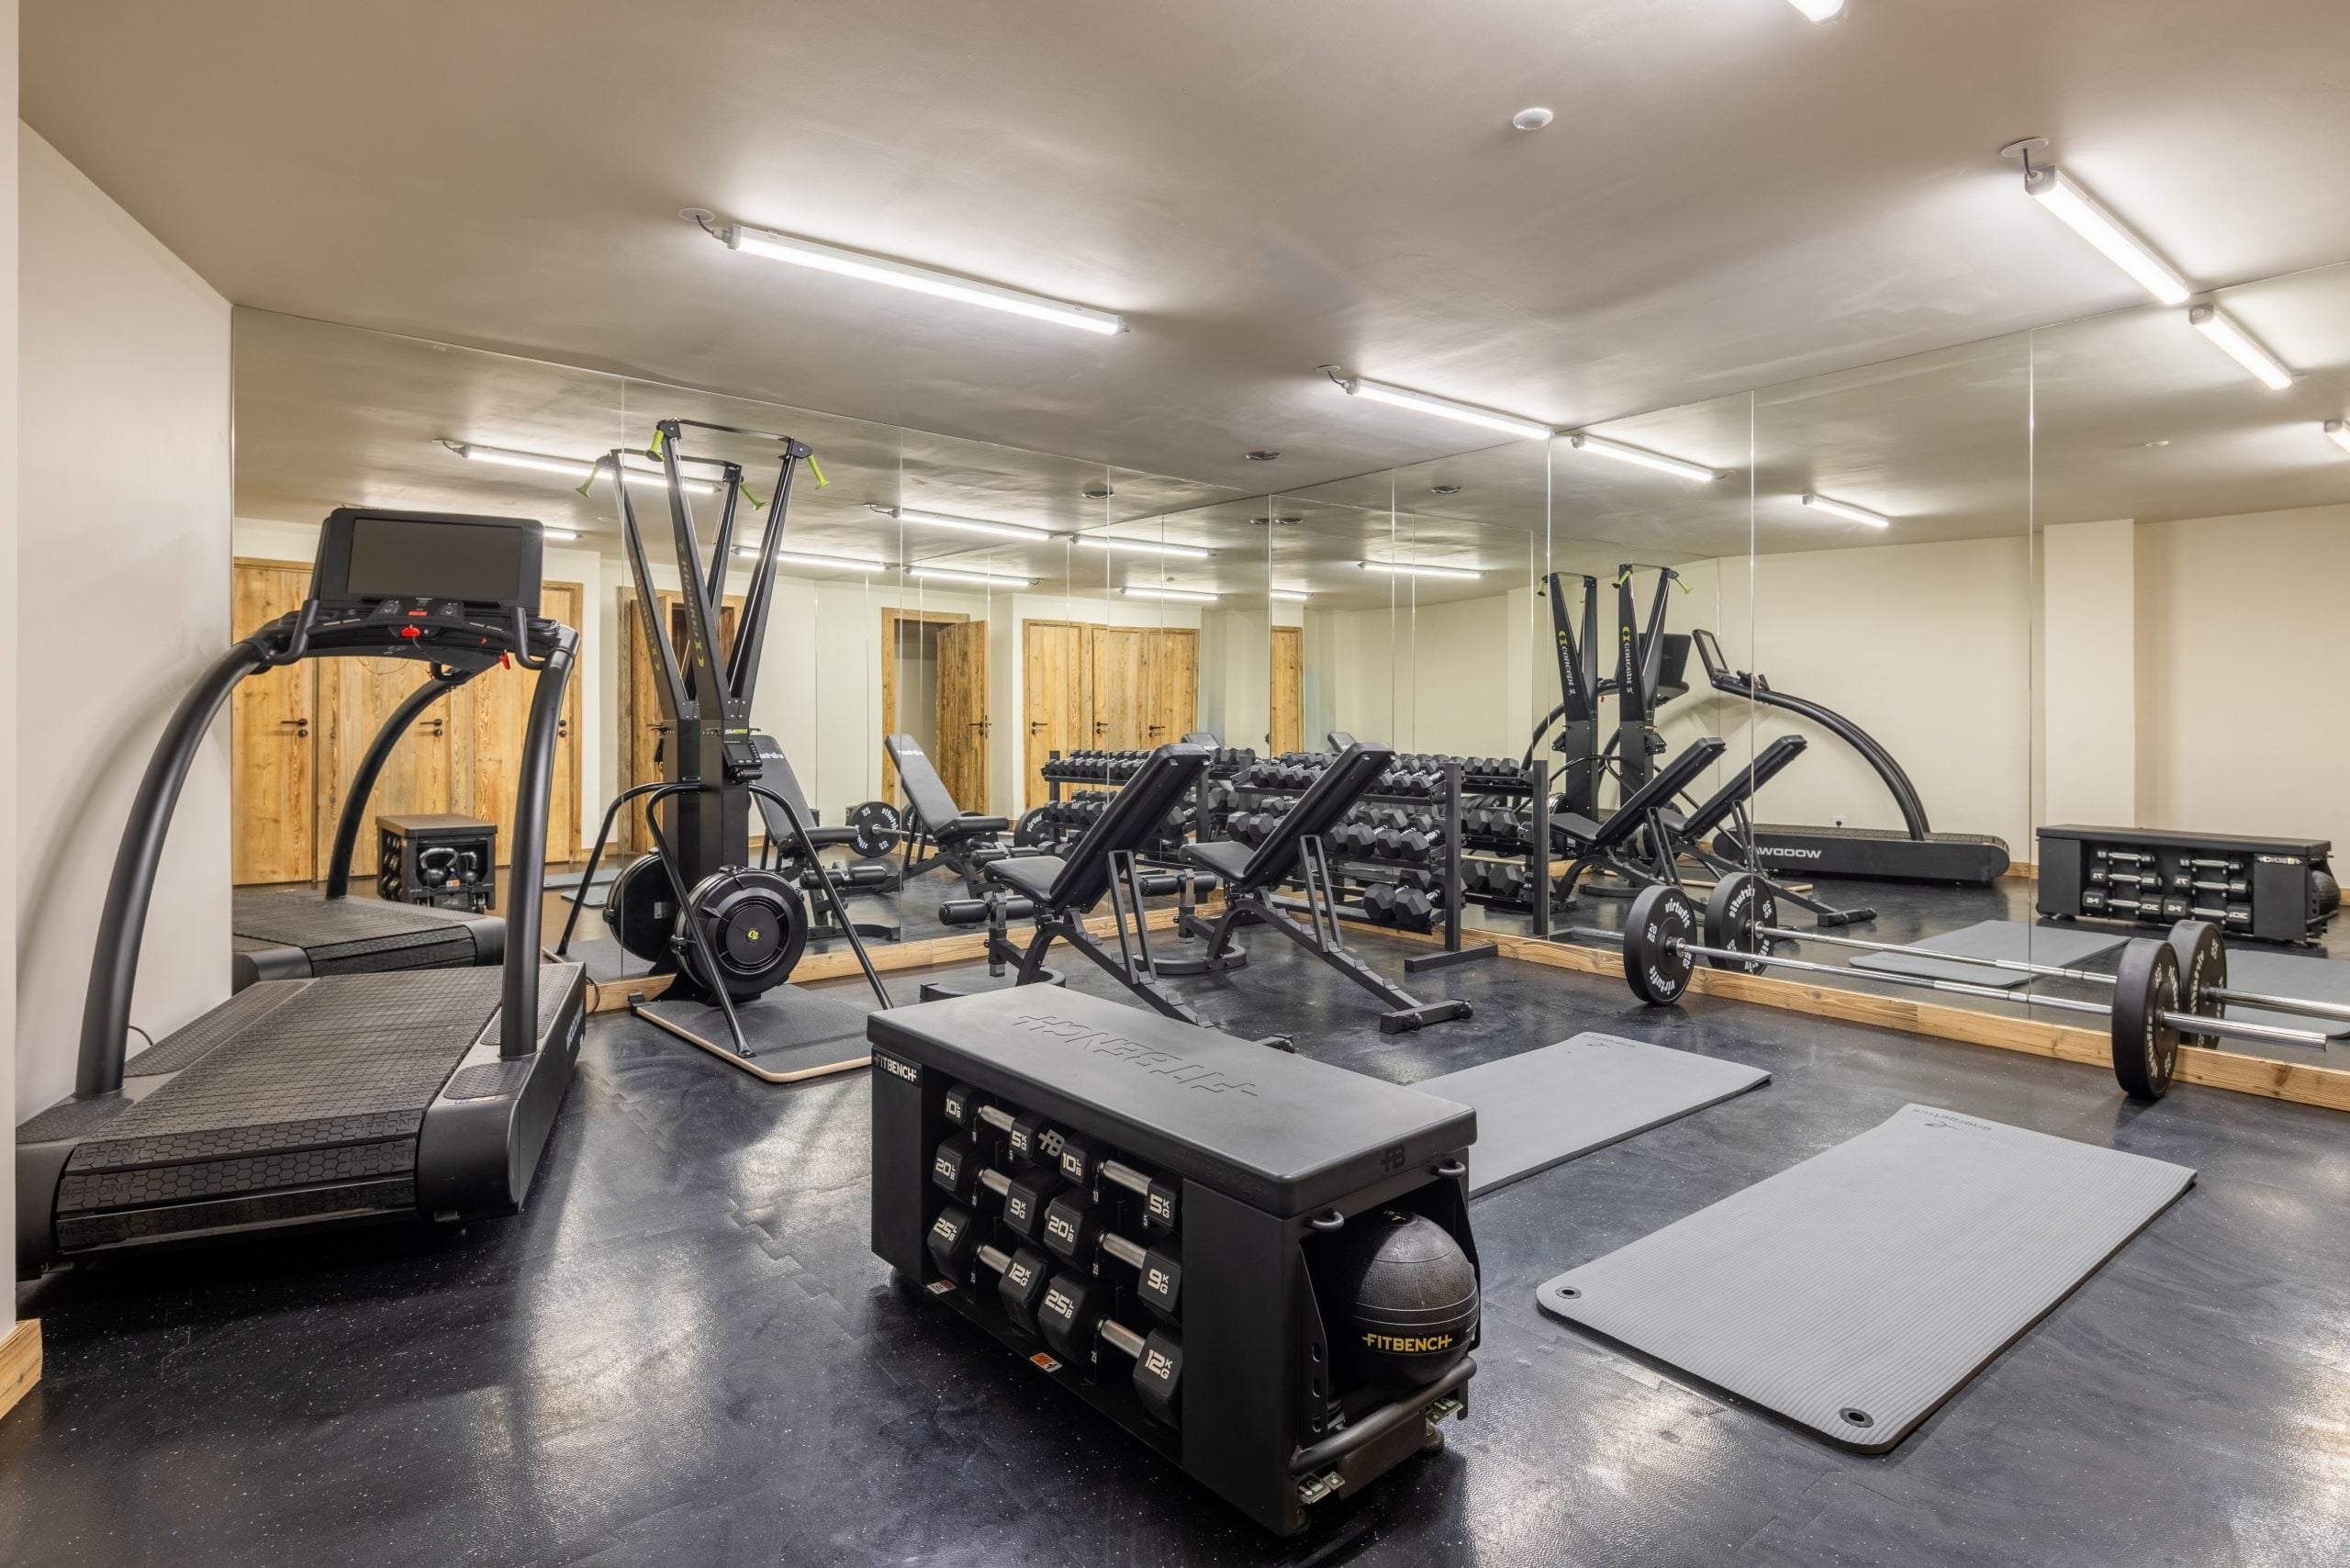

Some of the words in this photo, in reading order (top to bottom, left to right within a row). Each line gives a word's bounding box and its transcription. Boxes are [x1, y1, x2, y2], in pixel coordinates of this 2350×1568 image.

[1561, 645, 1574, 686] concept
[1026, 812, 1044, 833] virtuf
[1647, 932, 1655, 943] KG
[1649, 923, 1658, 935] 20
[874, 1052, 917, 1082] FITBENCH
[1362, 1332, 1453, 1351] FITBENCH
